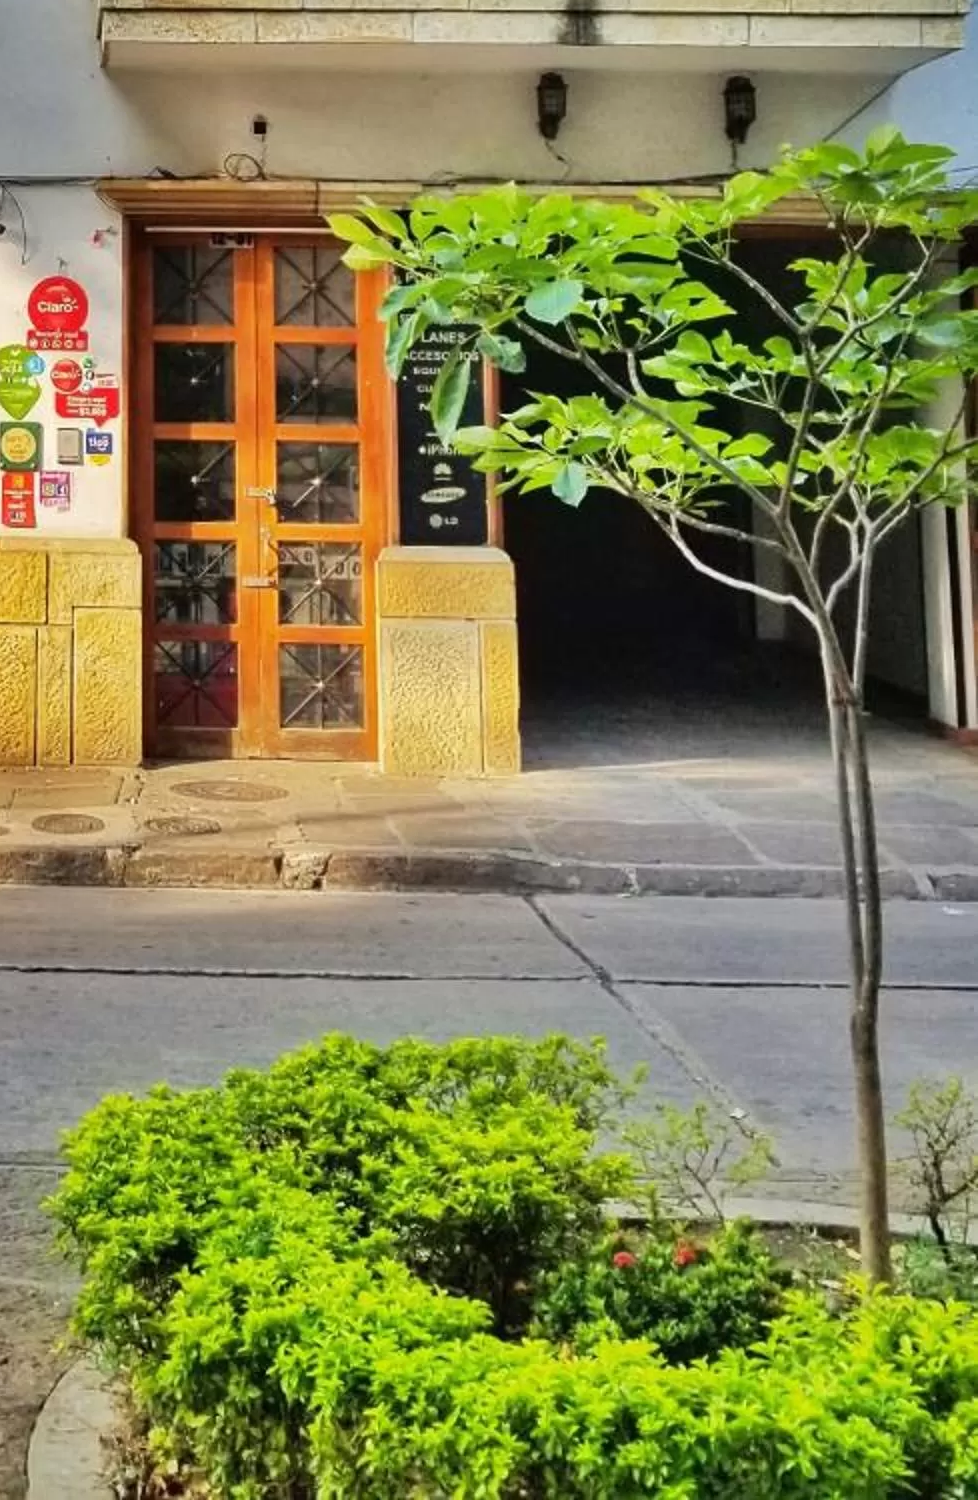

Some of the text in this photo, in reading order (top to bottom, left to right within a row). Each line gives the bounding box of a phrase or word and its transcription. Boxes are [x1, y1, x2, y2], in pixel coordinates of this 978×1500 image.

[37, 300, 73, 314] Claro
[419, 331, 466, 344] LANES
[406, 350, 479, 361] CCESOIOS
